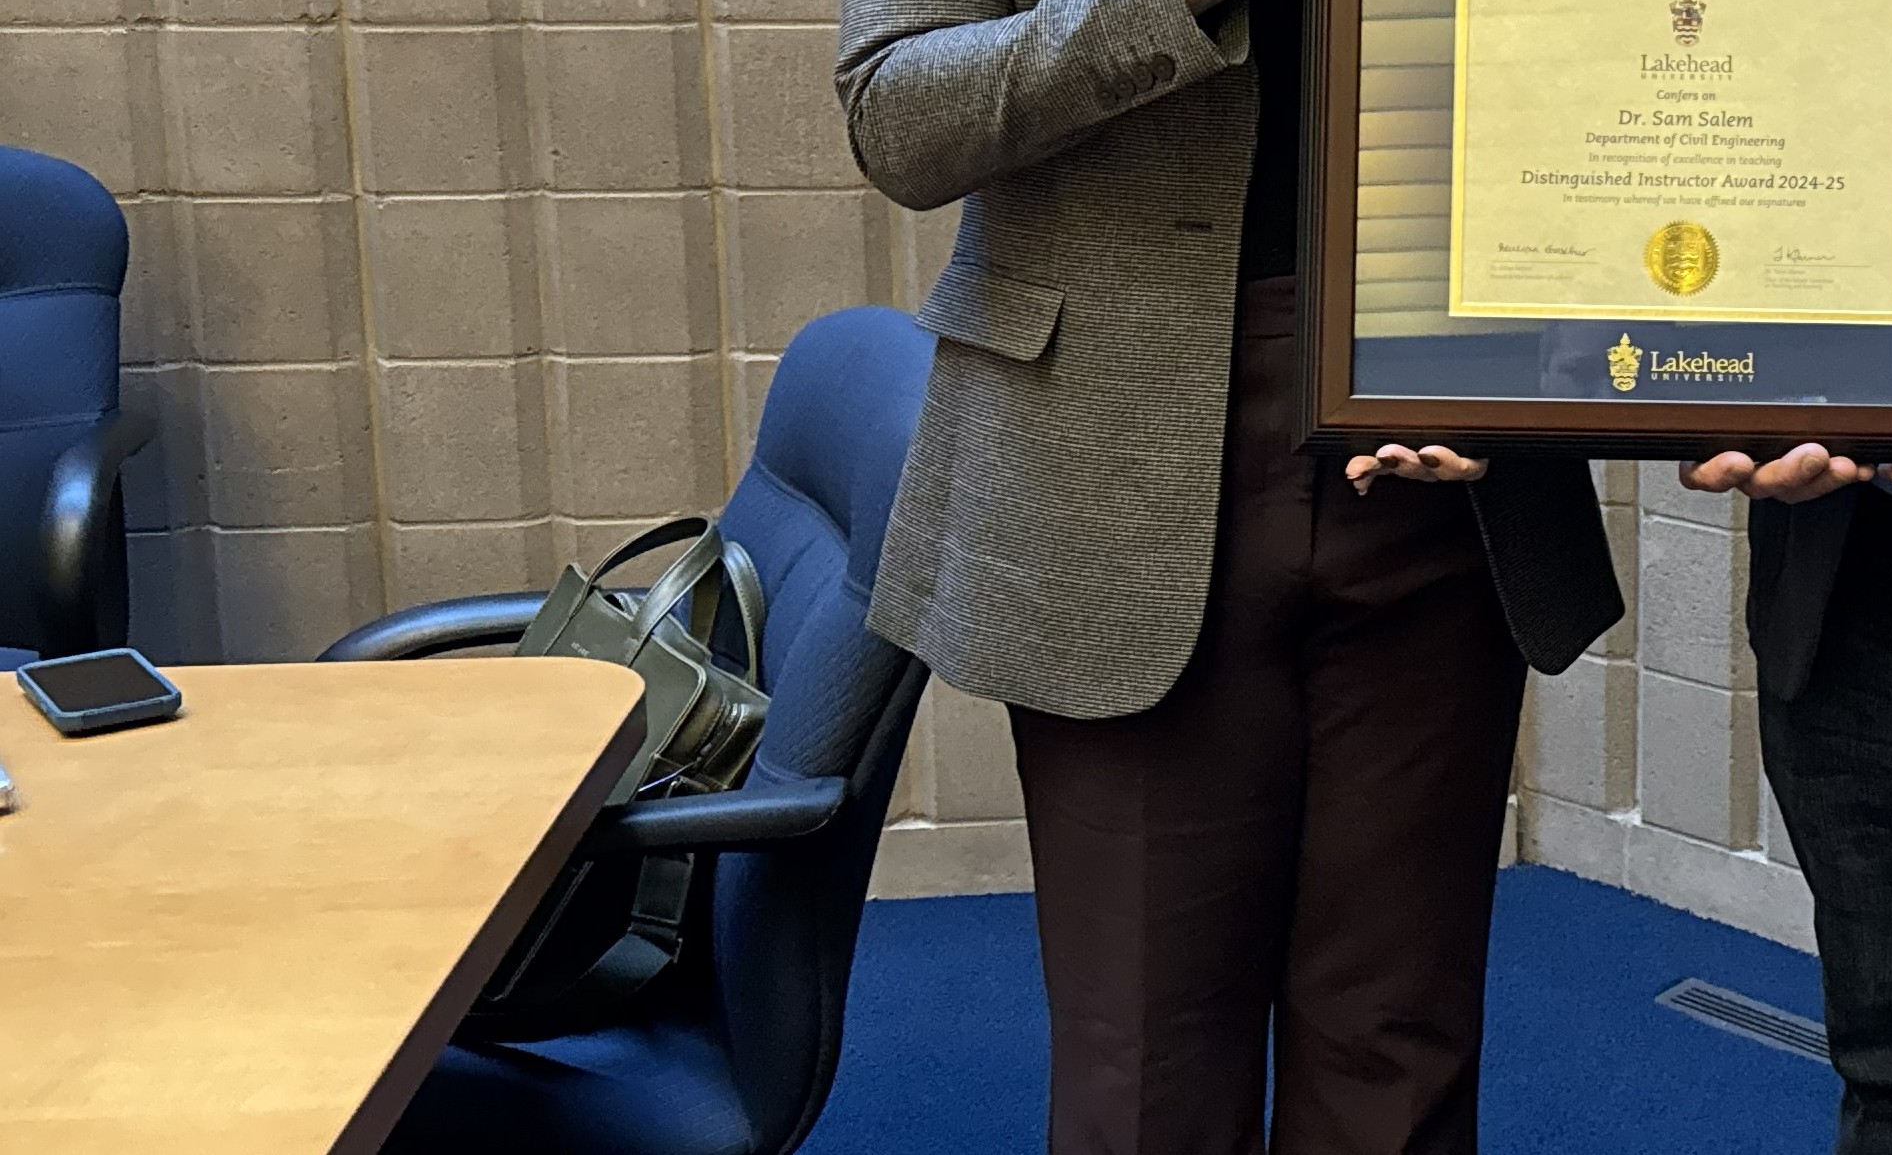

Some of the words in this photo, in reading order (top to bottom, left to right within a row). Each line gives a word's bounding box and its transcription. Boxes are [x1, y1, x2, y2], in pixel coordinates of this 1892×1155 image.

[1640, 53, 1733, 73] Lakehead
[1641, 73, 1732, 81] UNIVERSITY
[1656, 90, 1699, 103] Confers
[1702, 92, 1716, 101] on
[1618, 110, 1646, 126] Dr.
[1652, 111, 1693, 127] Sam
[1698, 111, 1754, 128] Salem
[1585, 133, 1660, 147] Department
[1663, 133, 1678, 148] of
[1679, 134, 1708, 146] Civil
[1711, 134, 1786, 150] Engineering
[1588, 152, 1599, 163] In
[1602, 153, 1657, 166] recognition
[1660, 153, 1673, 167] of
[1673, 154, 1724, 165] excellence
[1726, 155, 1736, 165] in
[1739, 155, 1783, 168] teaching
[1521, 169, 1632, 189] Distinguished
[1638, 172, 1717, 188] Instructor
[1721, 174, 1775, 189] Award
[1778, 175, 1846, 190] 2024-25
[1562, 194, 1573, 203] In
[1575, 194, 1621, 206] testimony
[1623, 194, 1662, 207] whereof
[1663, 197, 1677, 205] we
[1679, 195, 1702, 205] have
[1704, 195, 1737, 208] affixed
[1738, 198, 1755, 207] our
[1757, 198, 1806, 209] signatures
[1650, 350, 1755, 374] Lakehead
[1651, 373, 1754, 383] UNIVERSITY
